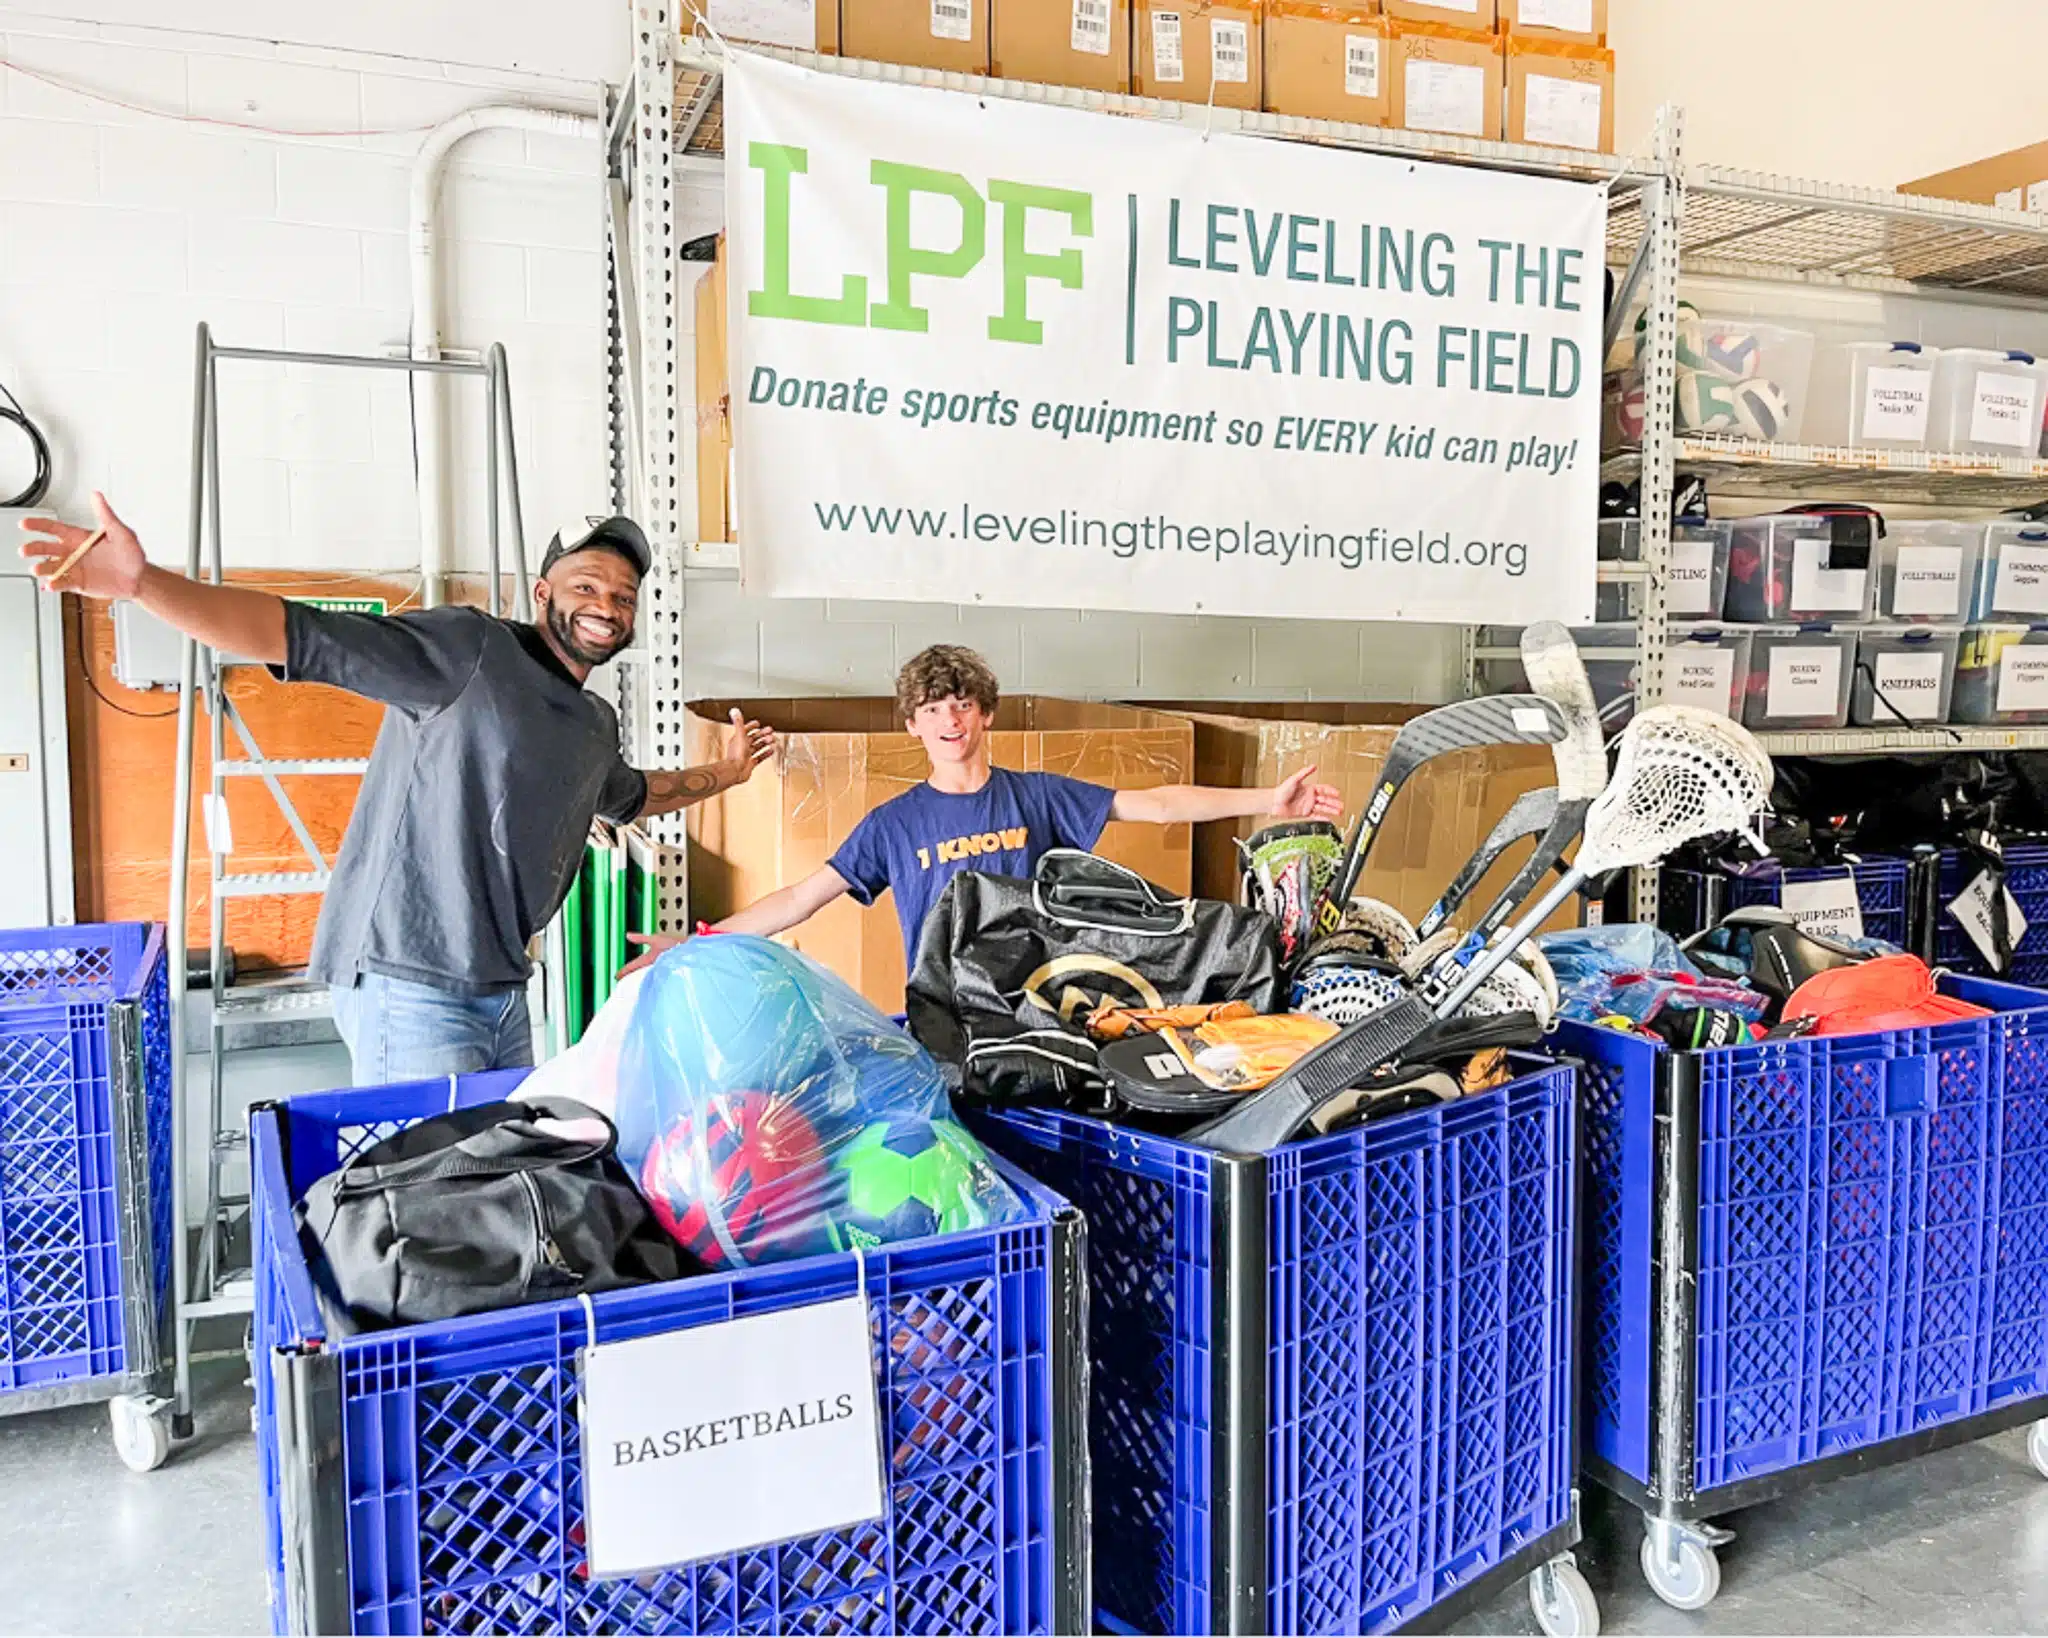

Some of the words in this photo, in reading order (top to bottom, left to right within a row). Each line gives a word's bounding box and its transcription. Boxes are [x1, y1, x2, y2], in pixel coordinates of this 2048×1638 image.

[748, 141, 1094, 344] LPF
[1168, 198, 1455, 298] LEVELING
[1478, 239, 1584, 312] THE
[1167, 296, 1413, 385] PLAYING
[1437, 325, 1582, 399] FIELD
[748, 366, 888, 415] Donate
[901, 387, 1019, 428] sports
[1031, 400, 1217, 443] equipment
[1226, 419, 1263, 447] so
[1274, 416, 1378, 455] EVERY
[1385, 424, 1436, 459] kid
[1443, 436, 1498, 463] can
[1505, 436, 1578, 475] play!
[1872, 388, 1924, 401] VOLLEYBALL
[814, 502, 1527, 576] www.levelingtheplayingfield.org
[1669, 568, 1707, 580] STLING
[1881, 678, 1936, 690] KNEEPADS
[936, 827, 1028, 865] KNOW
[1791, 907, 1854, 923] QUIPMENT
[1806, 925, 1839, 937] BAGS
[614, 1394, 853, 1466] BASKETBALLS
